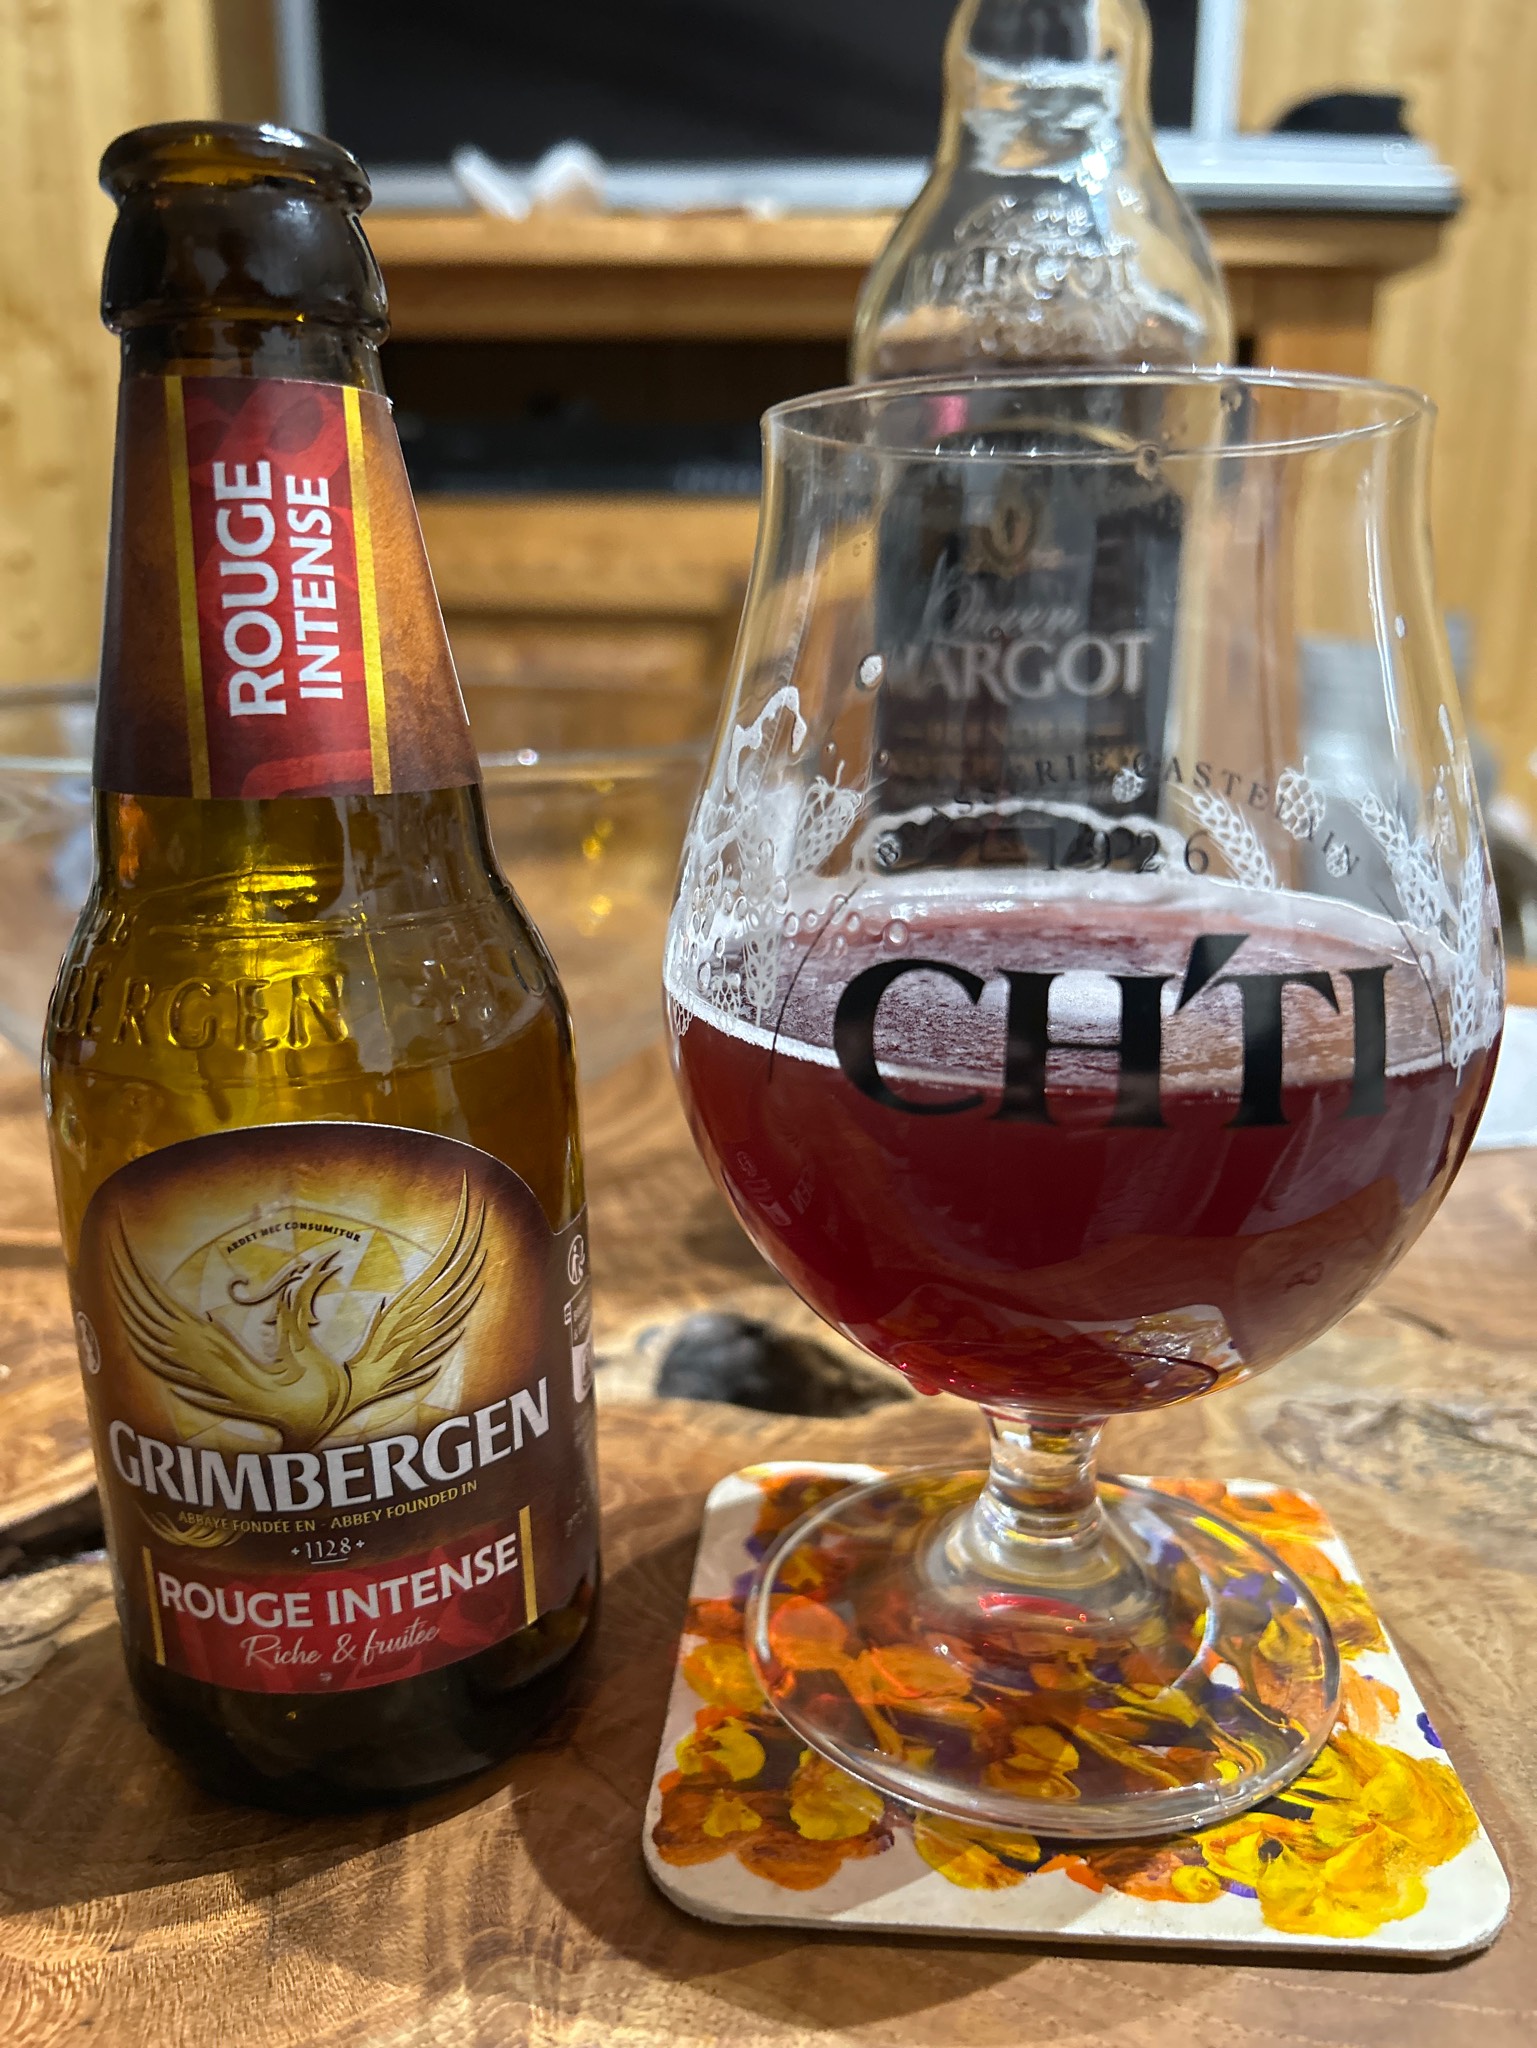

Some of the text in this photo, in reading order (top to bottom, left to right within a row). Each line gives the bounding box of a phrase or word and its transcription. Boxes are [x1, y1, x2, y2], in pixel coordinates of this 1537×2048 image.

[213, 459, 288, 719] ROUGE
[285, 475, 344, 701] INTENSE
[888, 627, 1155, 706] ARGOT
[284, 1221, 361, 1243] CONSUMITUR
[109, 1376, 550, 1515] GRIMBERGEN
[178, 1511, 229, 1530] ABBAYE
[296, 1520, 316, 1532] EN
[330, 1509, 382, 1530] ABBEY
[387, 1487, 458, 1519] FOUNDED
[460, 1479, 478, 1497] IN
[157, 1532, 520, 1629] ROUGE INTENSE
[240, 1615, 442, 1671] Riche & fruitée
